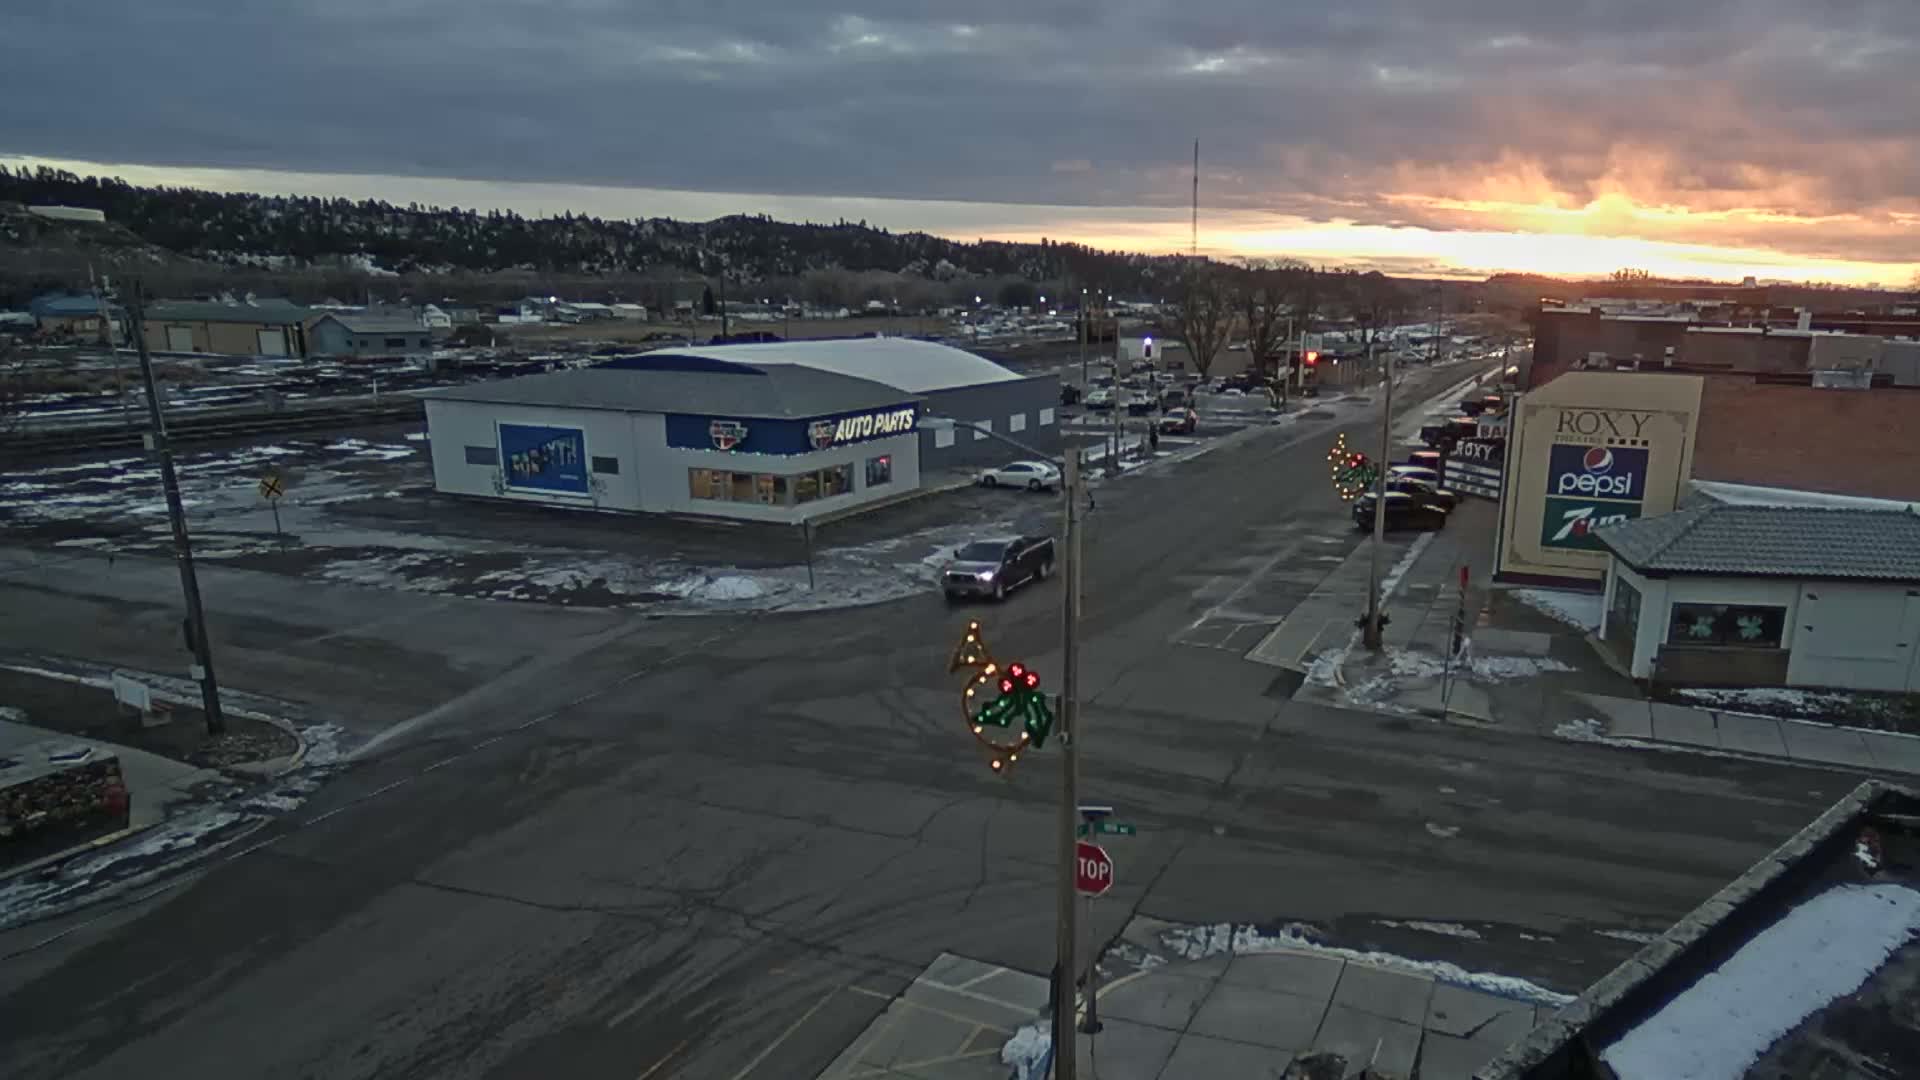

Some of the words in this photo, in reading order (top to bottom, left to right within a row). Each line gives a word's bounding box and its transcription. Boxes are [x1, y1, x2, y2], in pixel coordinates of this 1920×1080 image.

[834, 414, 873, 441] AUTO
[873, 408, 914, 436] PARTS
[1557, 411, 1654, 437] ROXY
[1456, 440, 1496, 460] ROXY
[1558, 472, 1632, 497] pepsi
[1078, 857, 1109, 881] TOP
